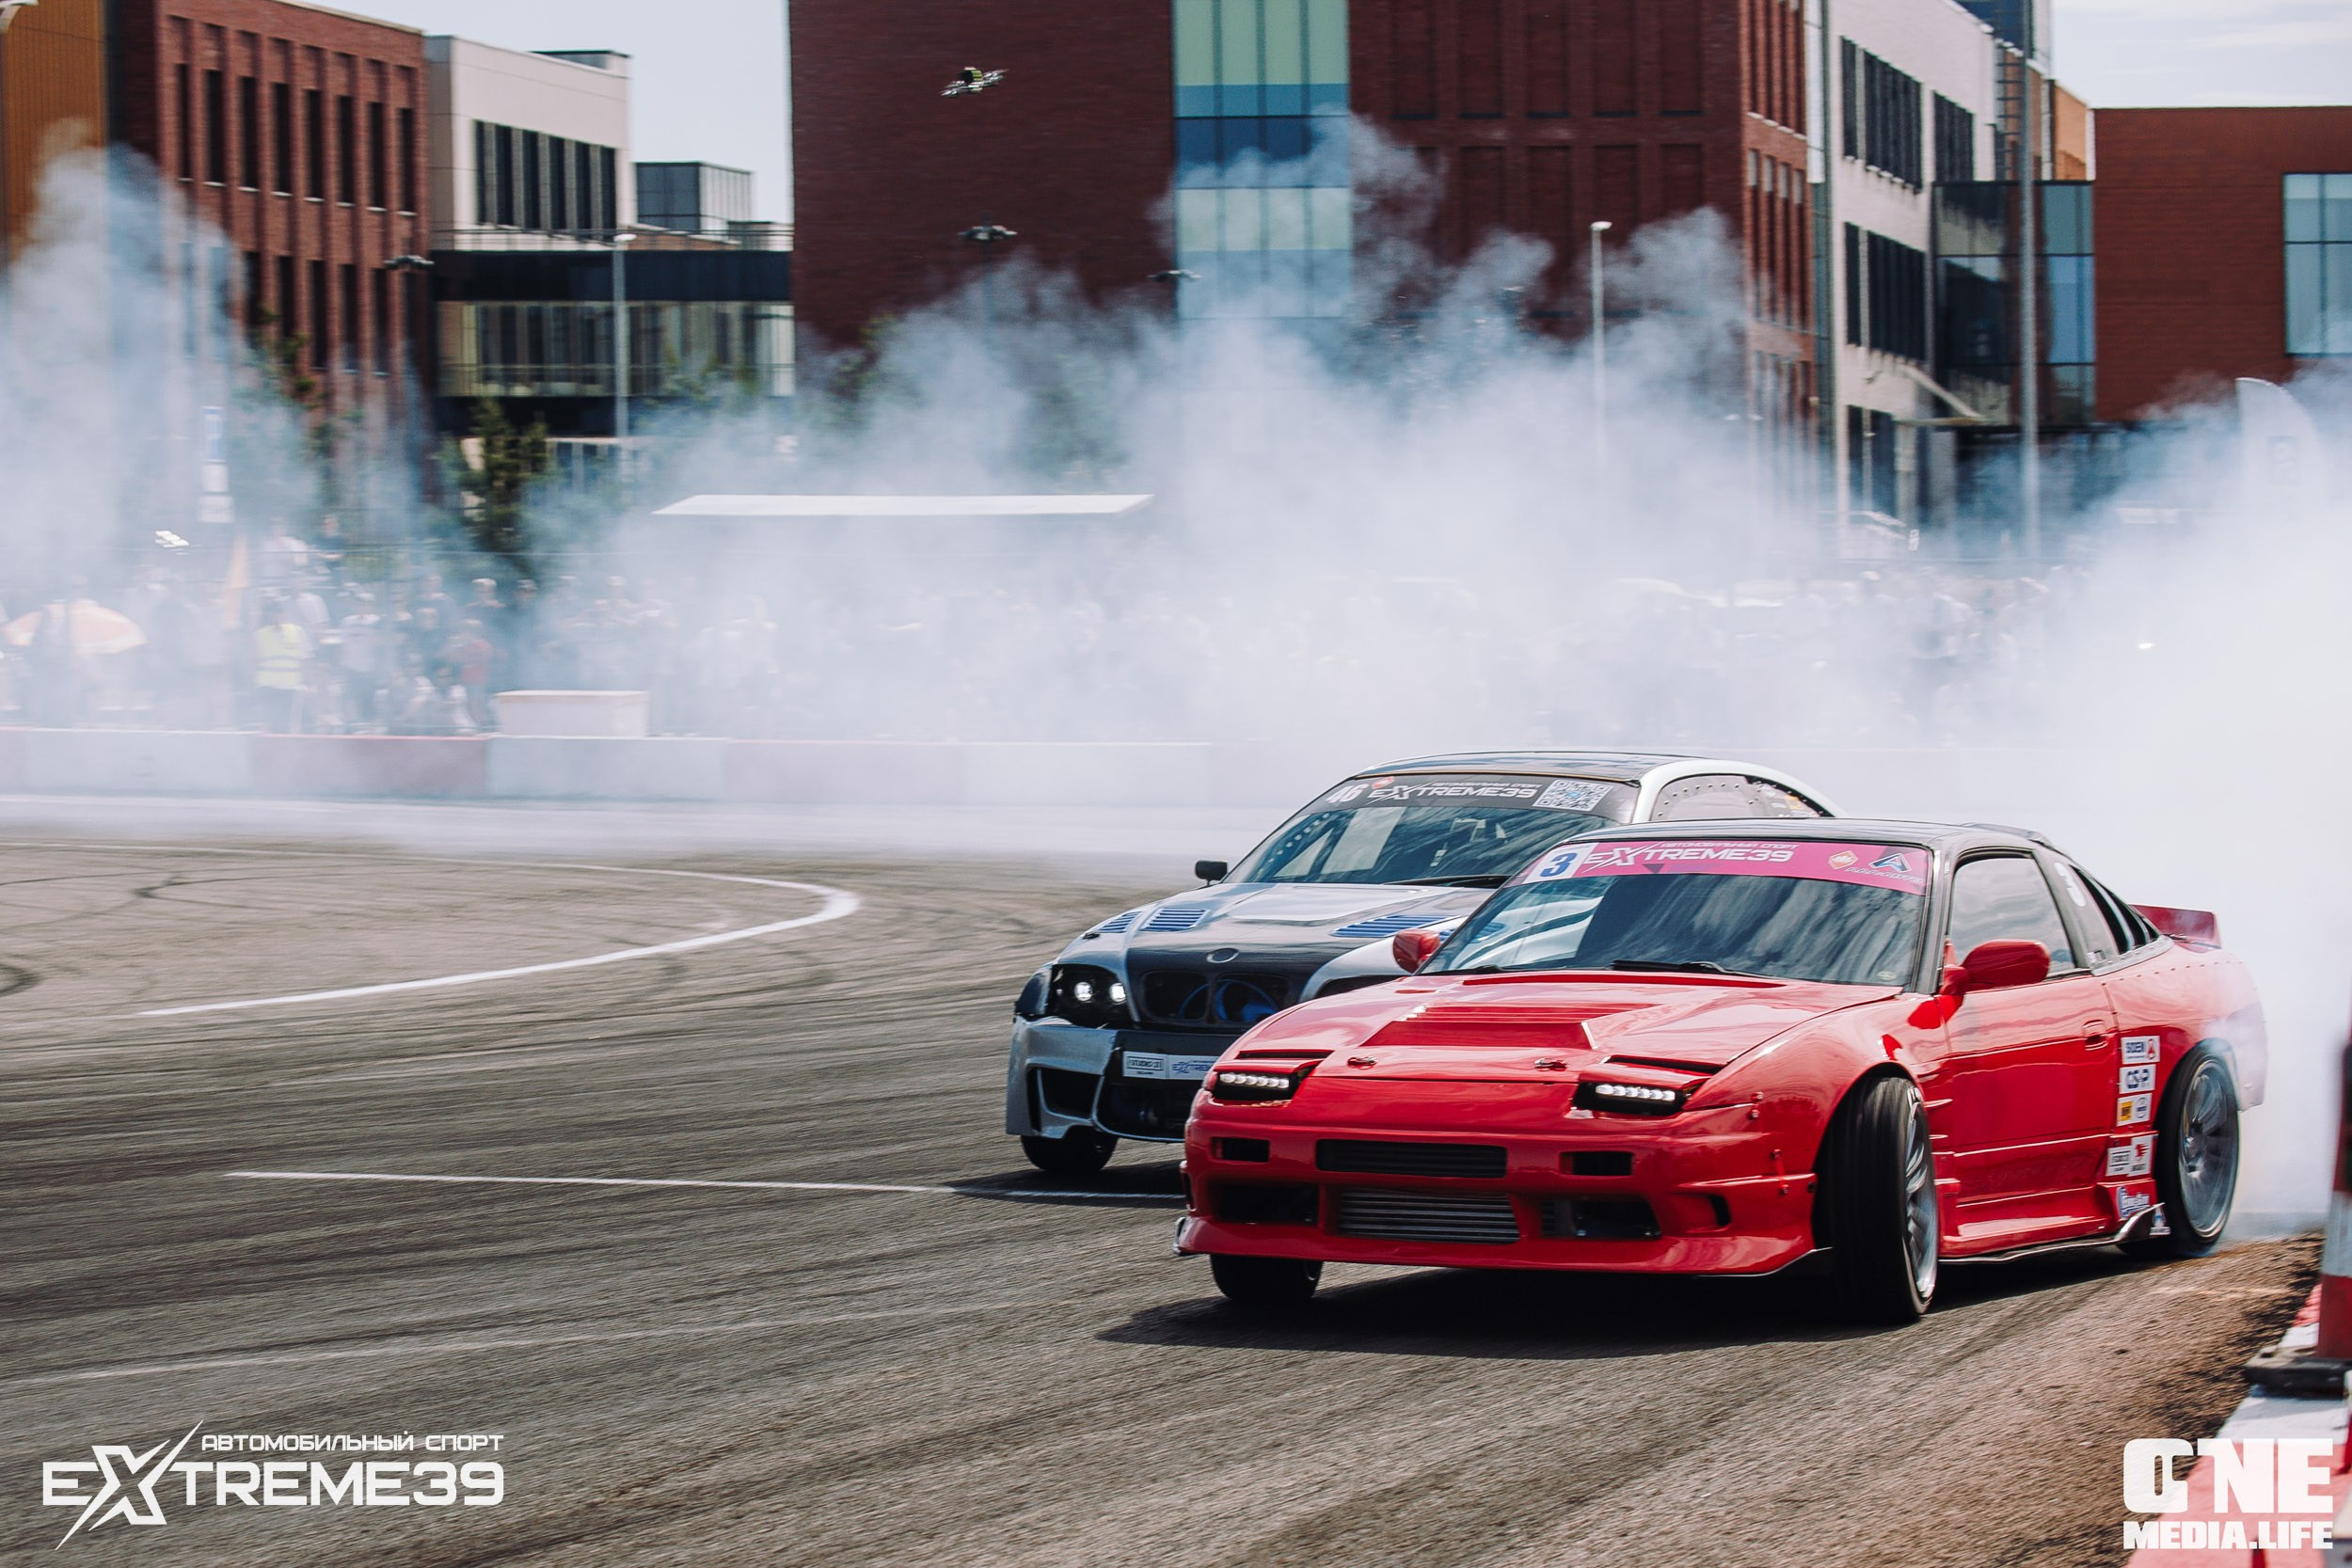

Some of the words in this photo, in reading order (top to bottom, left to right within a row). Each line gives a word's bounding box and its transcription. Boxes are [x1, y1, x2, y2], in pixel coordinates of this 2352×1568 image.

[1325, 783, 1370, 804] 46
[1364, 782, 1539, 805] EXTREME39
[1540, 852, 1579, 877] 3
[1581, 843, 1795, 874] EXTREME39
